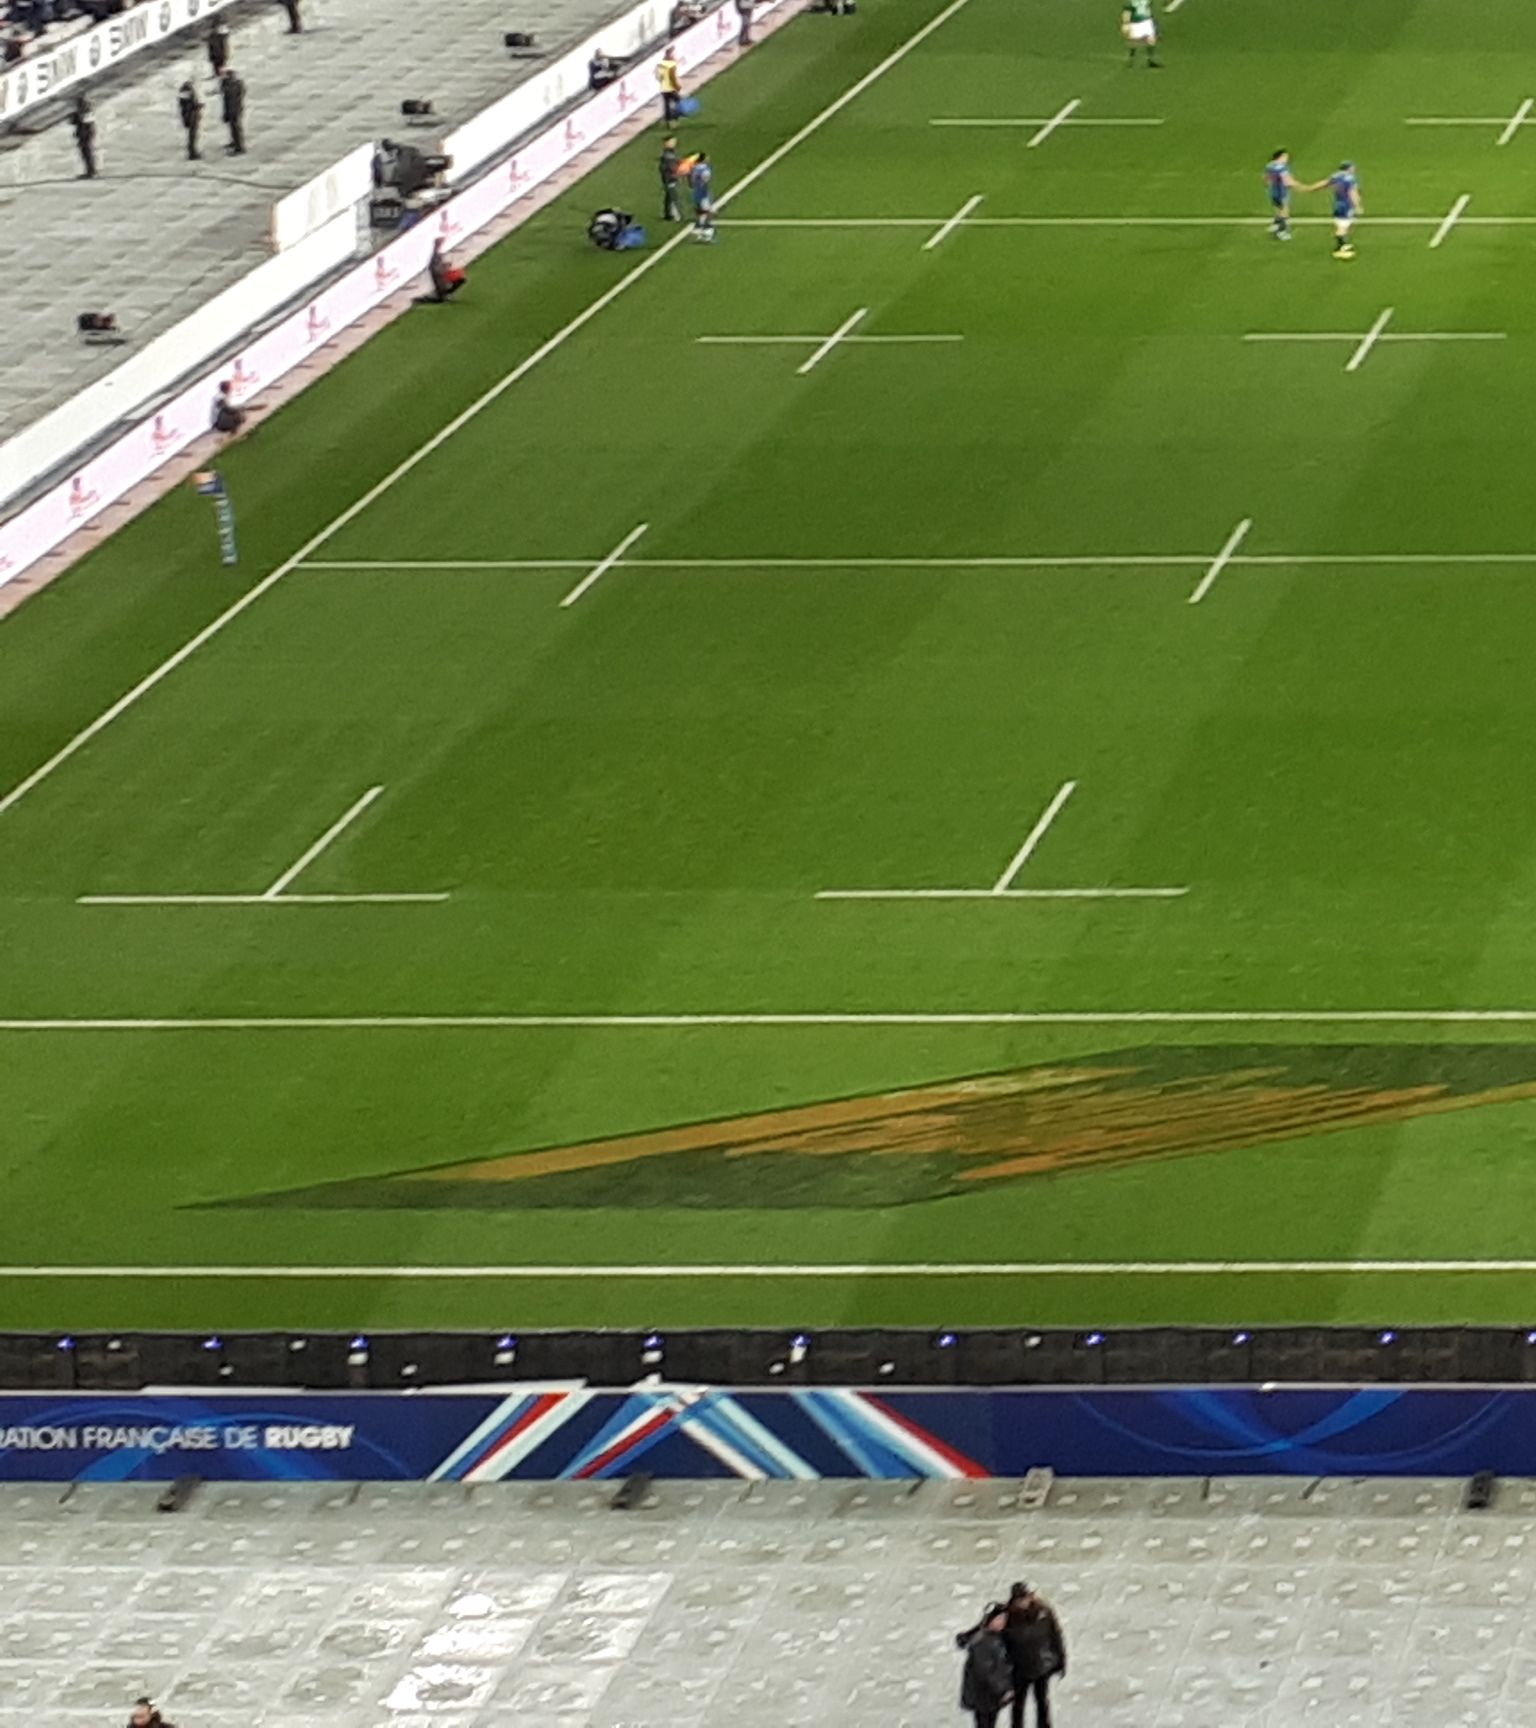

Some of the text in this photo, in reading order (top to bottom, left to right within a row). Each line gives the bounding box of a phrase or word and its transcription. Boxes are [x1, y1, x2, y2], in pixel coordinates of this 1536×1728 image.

[82, 1424, 218, 1456] FRANÇAISE
[223, 1425, 259, 1450] DE
[264, 1423, 355, 1451] RUGBY
